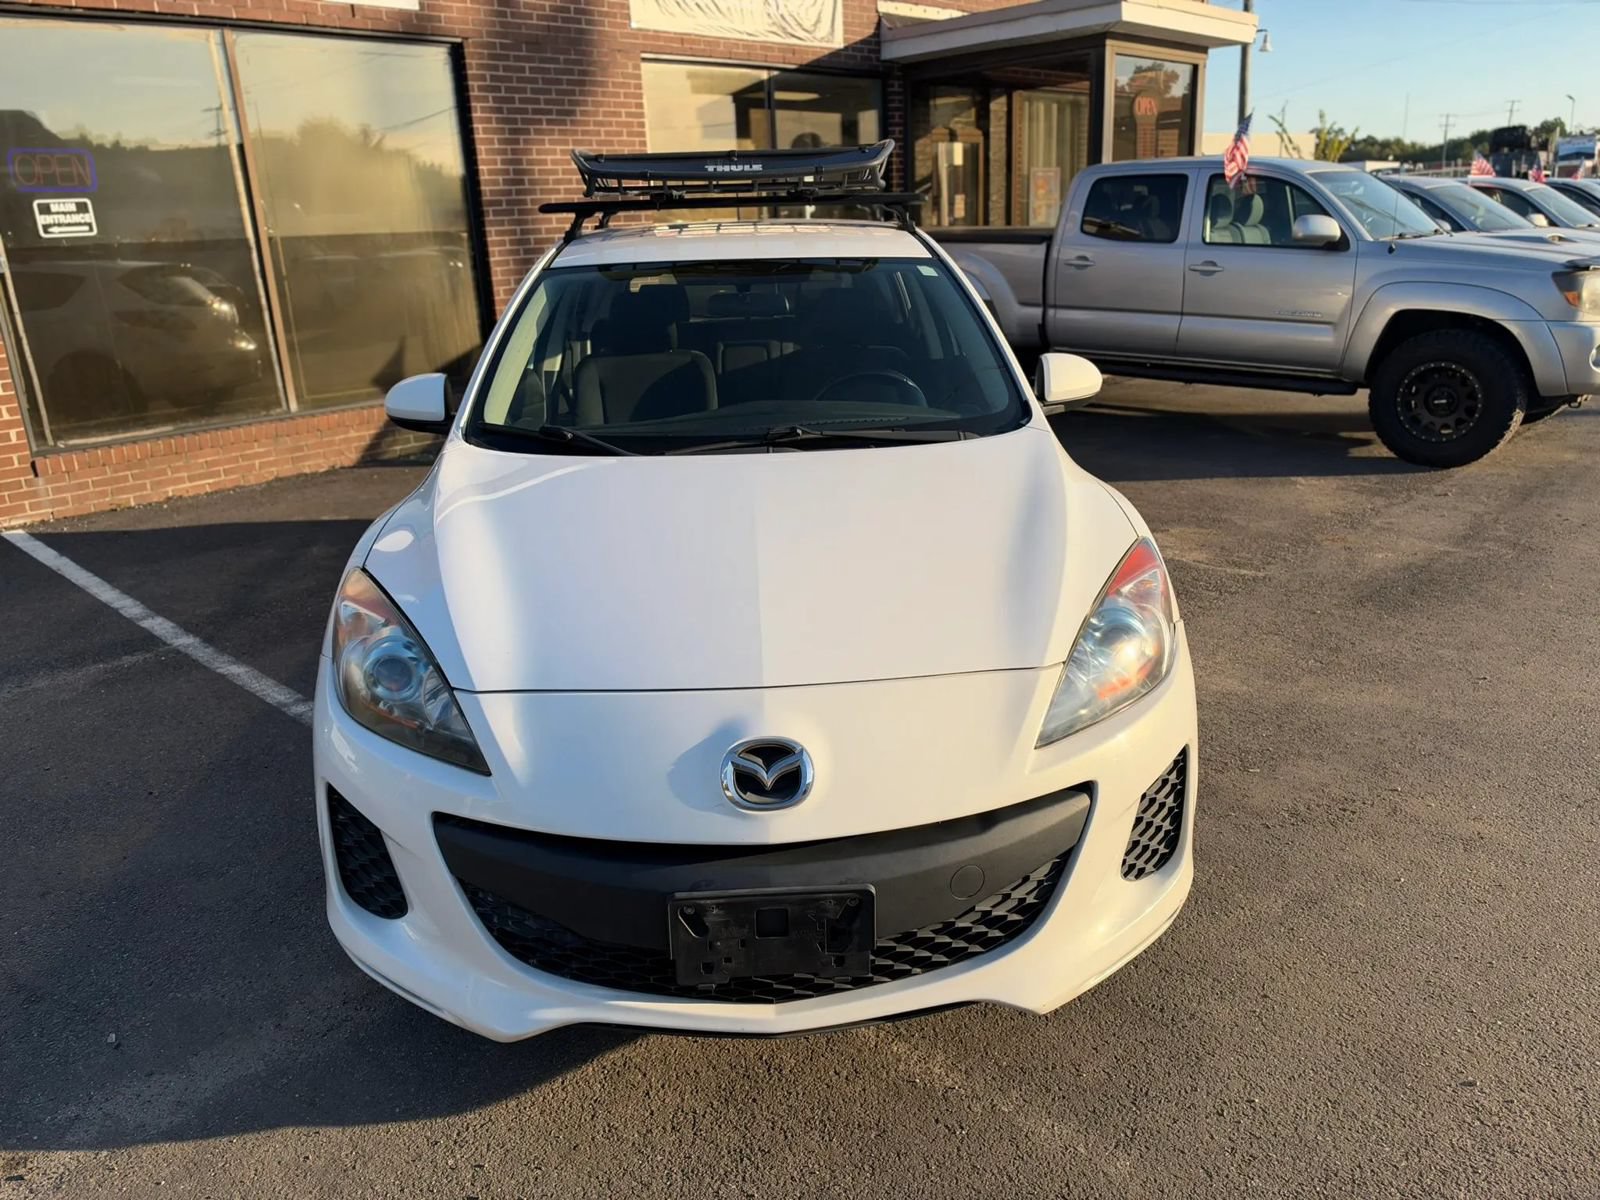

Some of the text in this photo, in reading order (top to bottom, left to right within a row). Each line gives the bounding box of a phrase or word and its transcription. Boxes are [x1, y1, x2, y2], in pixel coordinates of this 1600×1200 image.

[15, 153, 92, 186] OPEN
[704, 164, 763, 172] THULE
[49, 202, 77, 213] MAIN
[39, 212, 93, 225] ENTRANCE
